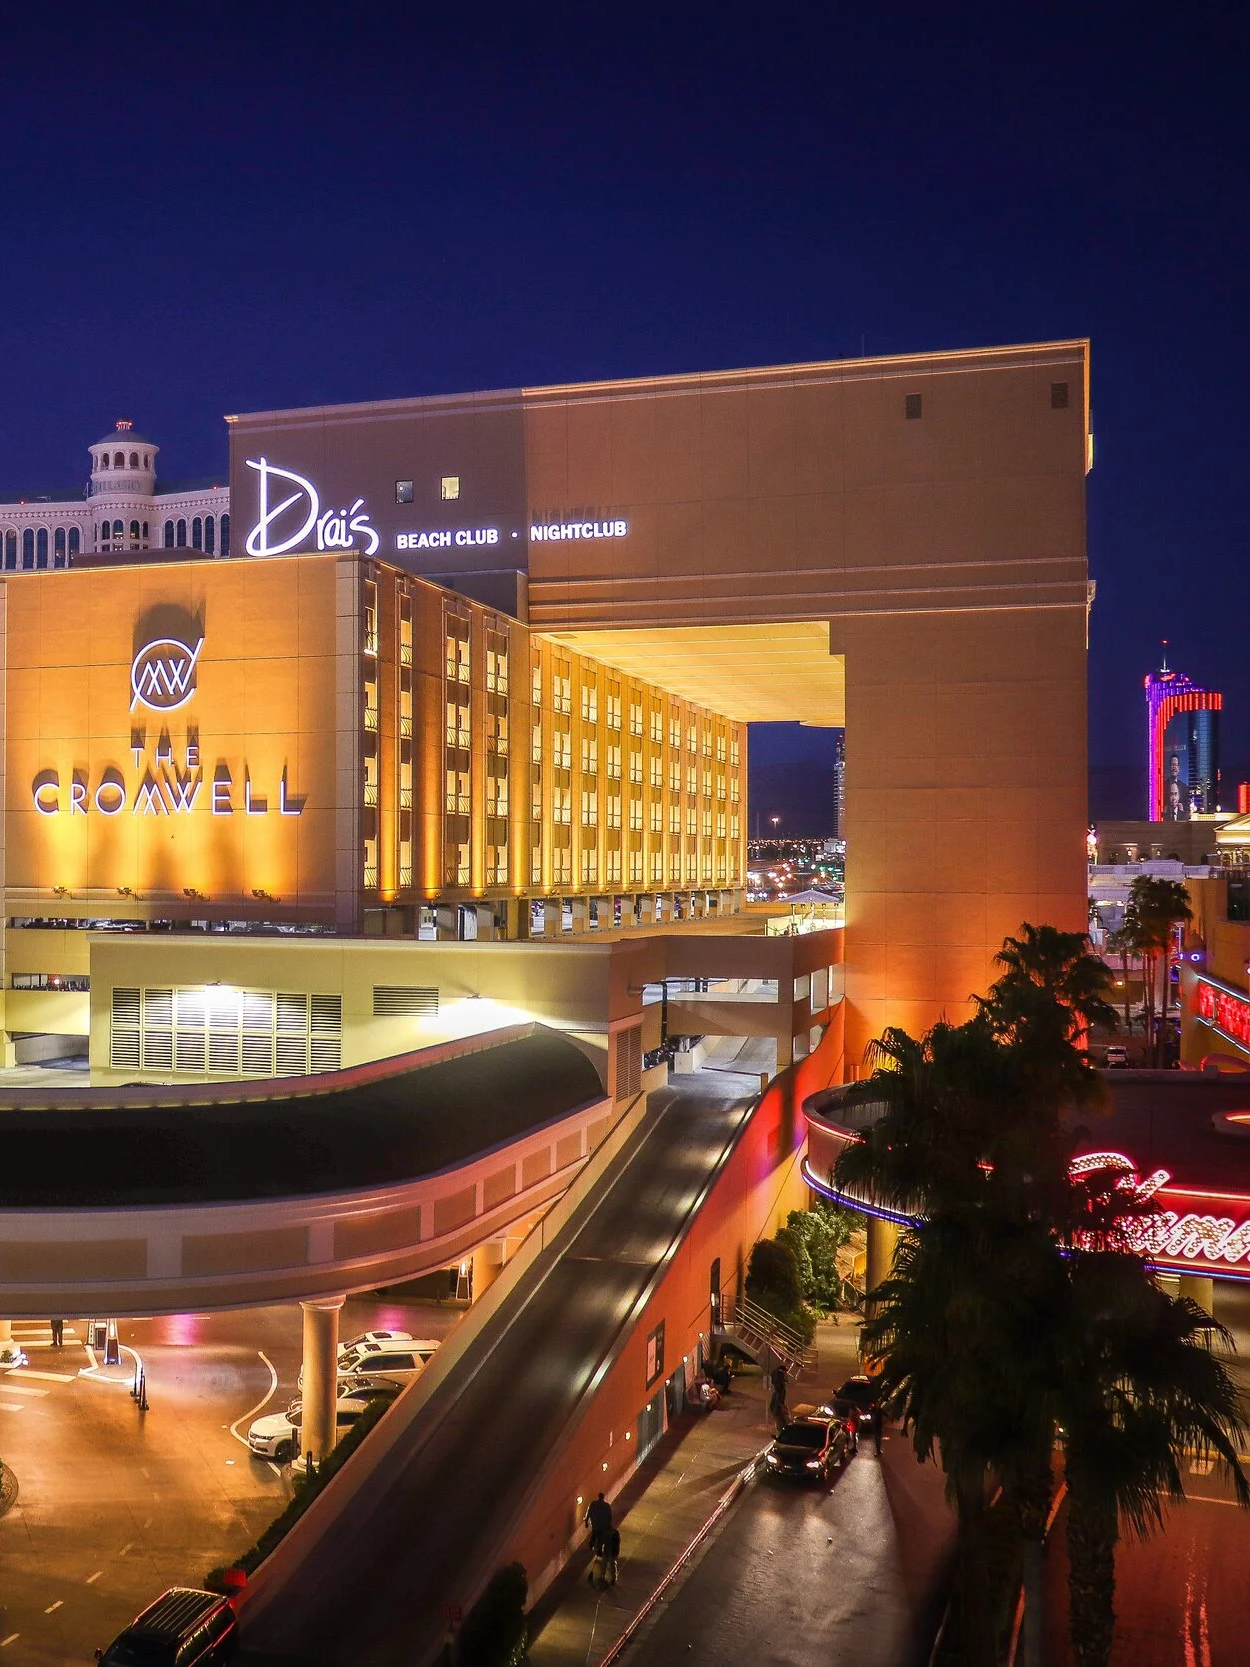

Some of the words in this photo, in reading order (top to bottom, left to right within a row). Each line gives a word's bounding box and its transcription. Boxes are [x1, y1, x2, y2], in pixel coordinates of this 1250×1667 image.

[245, 457, 380, 557] Drai's
[396, 530, 451, 549] BEACH
[454, 527, 499, 546] CLUB
[530, 521, 627, 541] NIGHTCLUB
[130, 746, 200, 768] THE
[34, 780, 301, 816] CROMWELL
